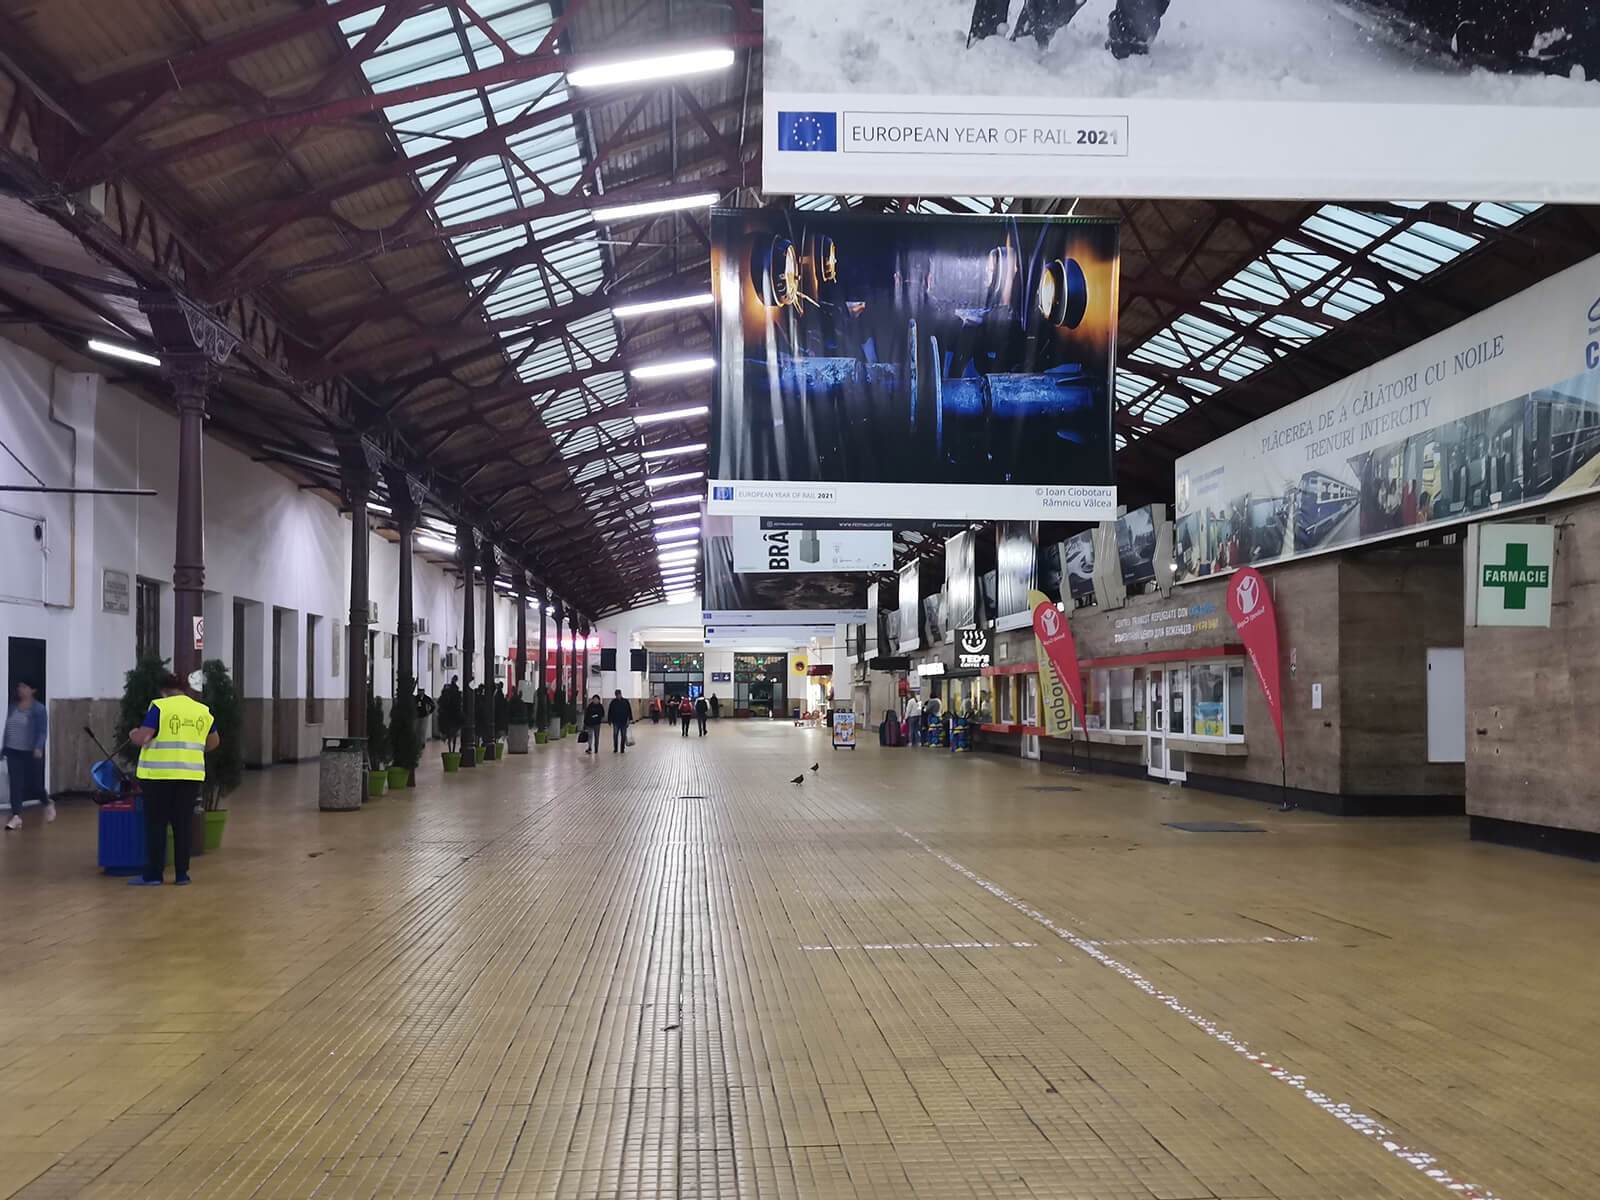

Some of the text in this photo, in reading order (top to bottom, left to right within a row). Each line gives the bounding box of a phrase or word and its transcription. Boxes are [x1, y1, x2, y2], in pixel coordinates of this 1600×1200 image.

[852, 126, 1118, 145] EUROPEAN YEAR OF RAIL 2021
[1318, 409, 1335, 432] DE
[1339, 406, 1348, 424] A
[1425, 360, 1447, 386] CU
[1453, 334, 1506, 375] NOILE
[1305, 397, 1432, 461] TRENURI INTERCITY
[738, 491, 773, 499] EUROPEAN
[775, 491, 791, 499] YEAR
[792, 491, 801, 499] OF
[1045, 488, 1066, 496] Ioan
[1068, 487, 1112, 497] Ciobotaru
[1485, 570, 1547, 583] FARMACIE
